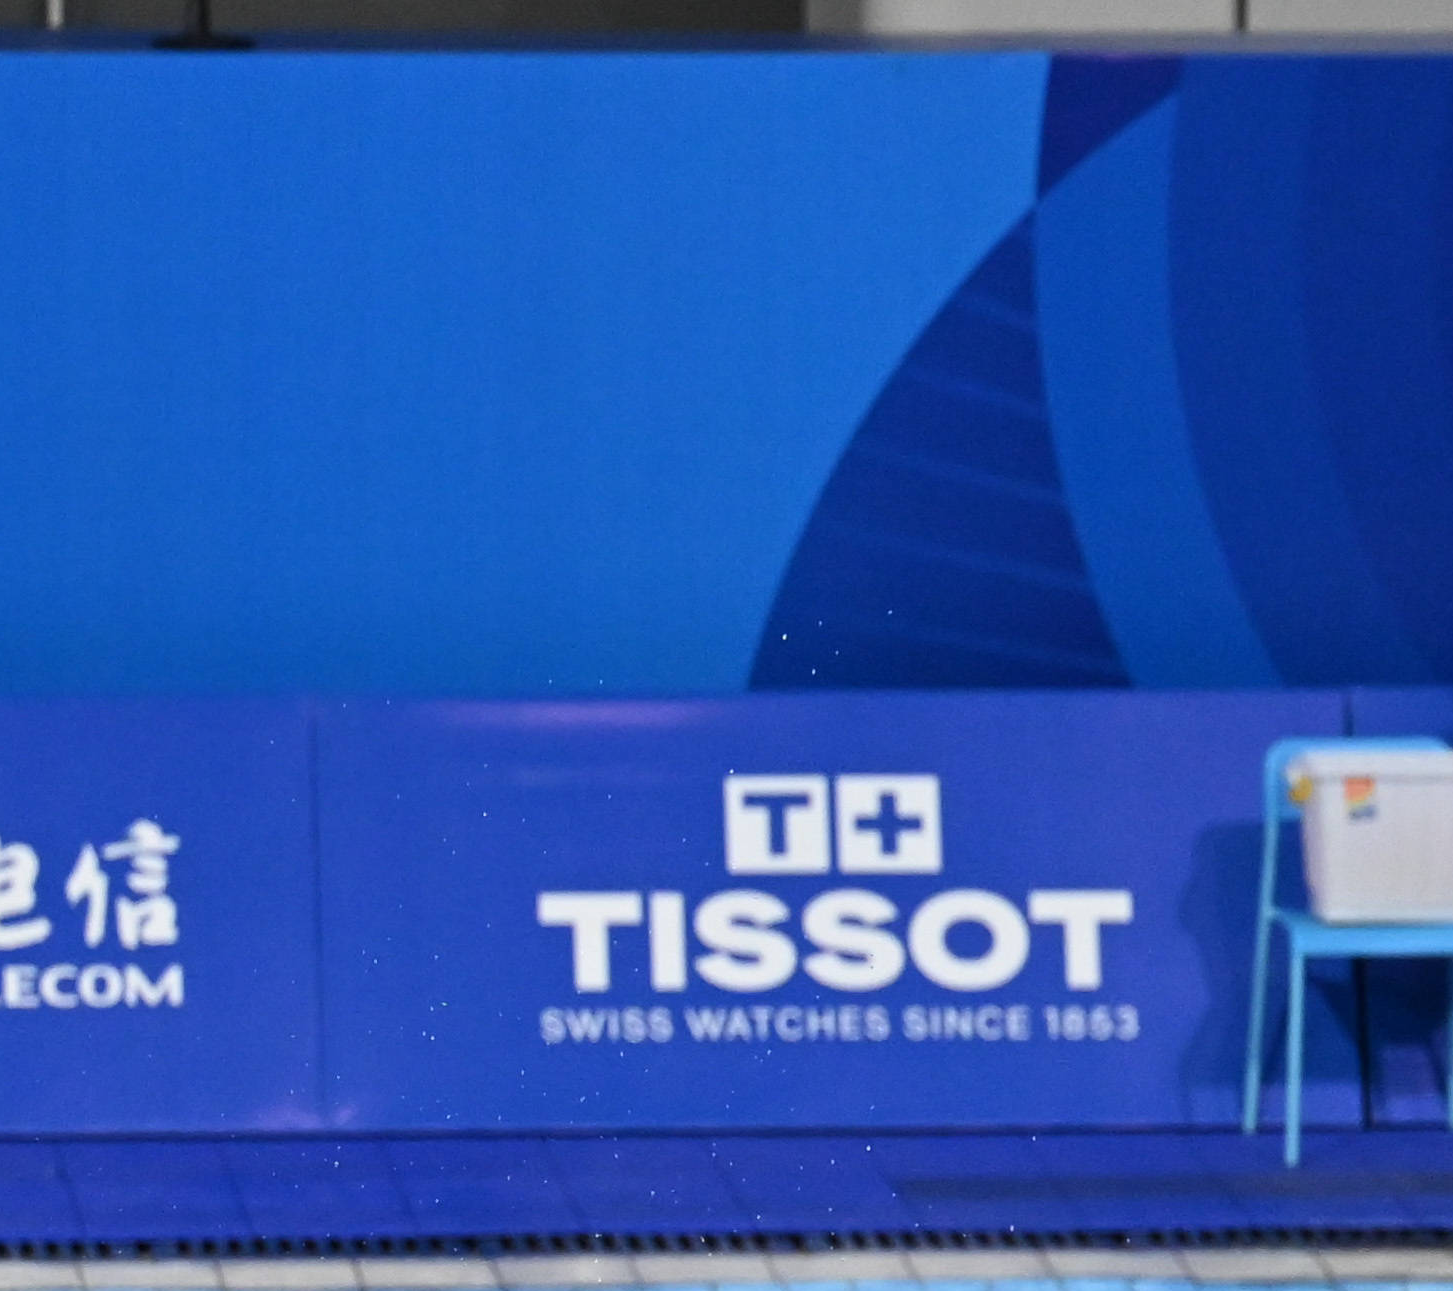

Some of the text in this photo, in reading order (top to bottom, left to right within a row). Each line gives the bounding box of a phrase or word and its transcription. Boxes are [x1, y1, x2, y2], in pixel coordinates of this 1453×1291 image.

[537, 888, 1134, 992] TISSOT
[540, 1007, 674, 1045] SWISS
[684, 1005, 890, 1043] WATCHES
[903, 1005, 1031, 1042] SINCE
